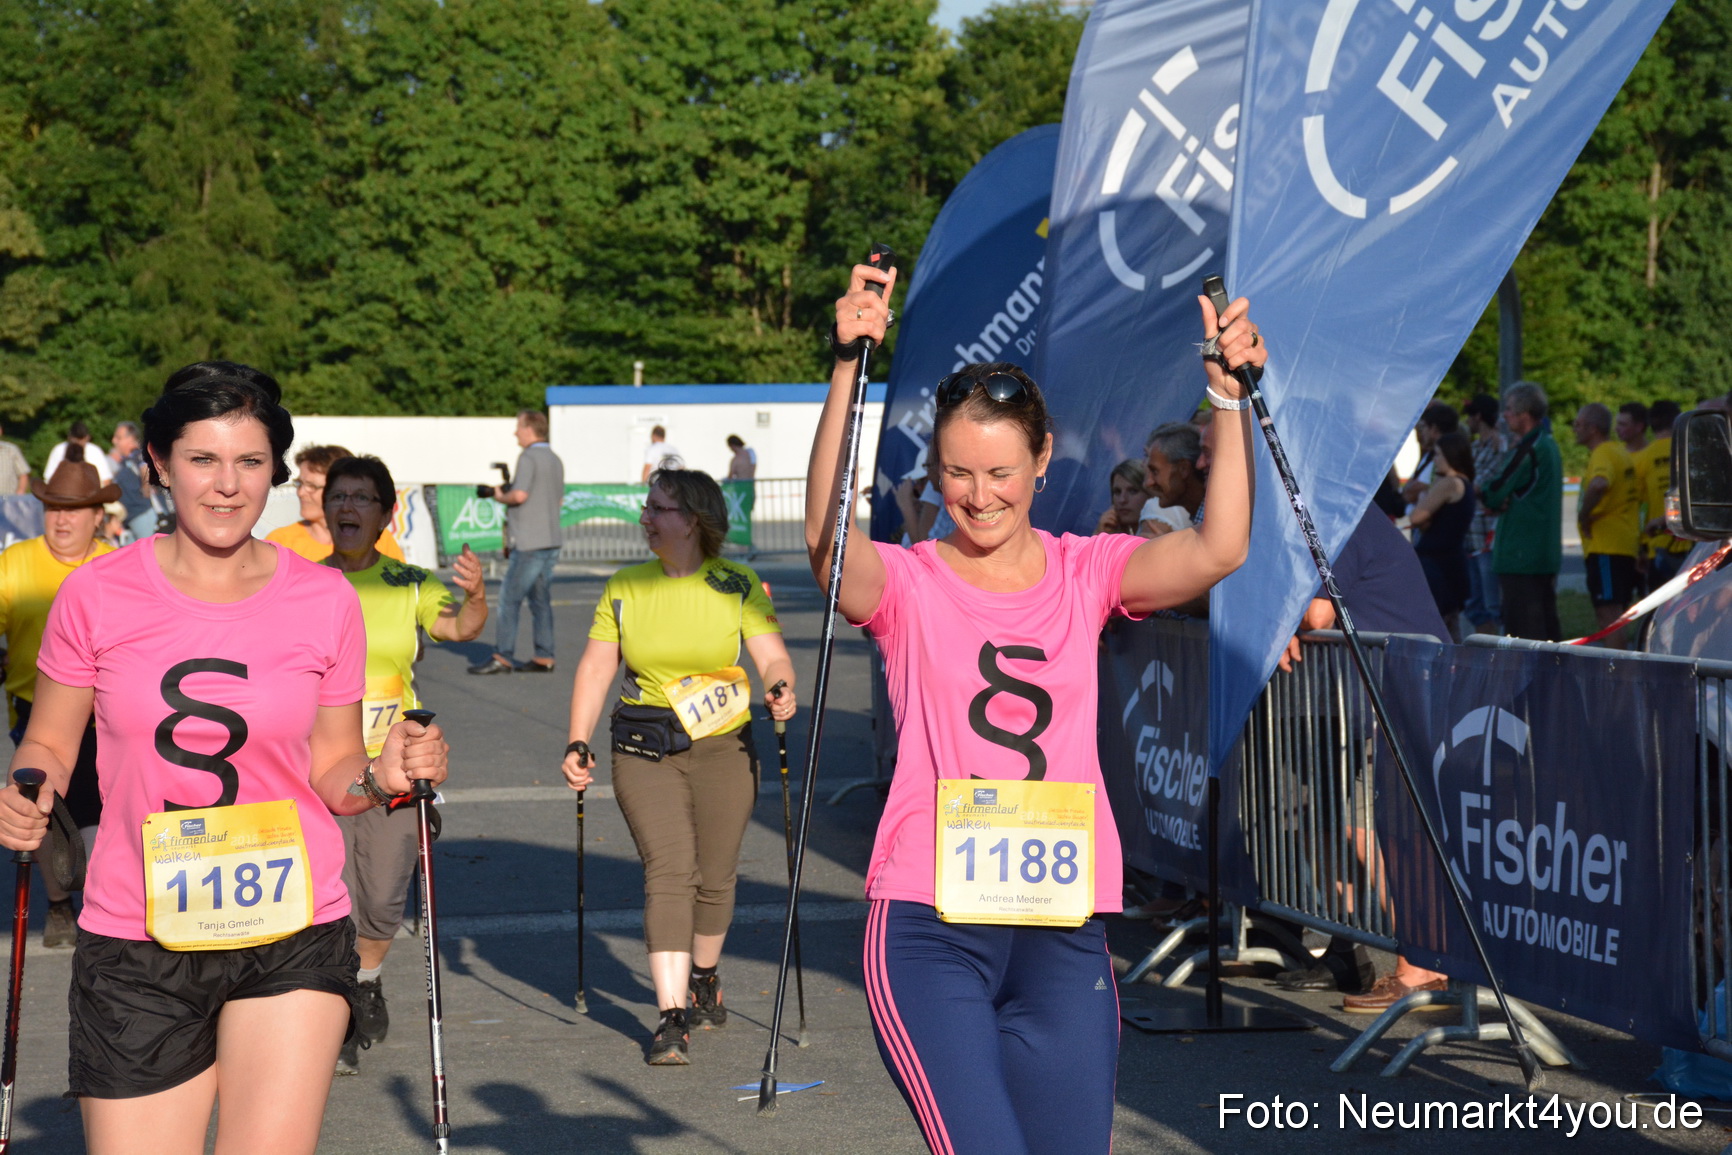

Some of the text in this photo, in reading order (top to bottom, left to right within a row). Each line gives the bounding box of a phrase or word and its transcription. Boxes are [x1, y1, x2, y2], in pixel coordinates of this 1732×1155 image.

[1492, 0, 1589, 130] AUT
[1135, 724, 1209, 807] Fischer
[946, 818, 992, 830] walken
[962, 804, 1019, 815] firmenlauf
[170, 830, 229, 847] firmenlauf
[1460, 791, 1628, 906] Fischer
[154, 851, 202, 865] walken
[955, 837, 1079, 885] 1188
[166, 857, 294, 913] 1187
[978, 893, 1053, 904] Andrea Mederer
[198, 917, 264, 931] Tanja Gmelch
[1483, 901, 1620, 966] AUTOMOBILE
